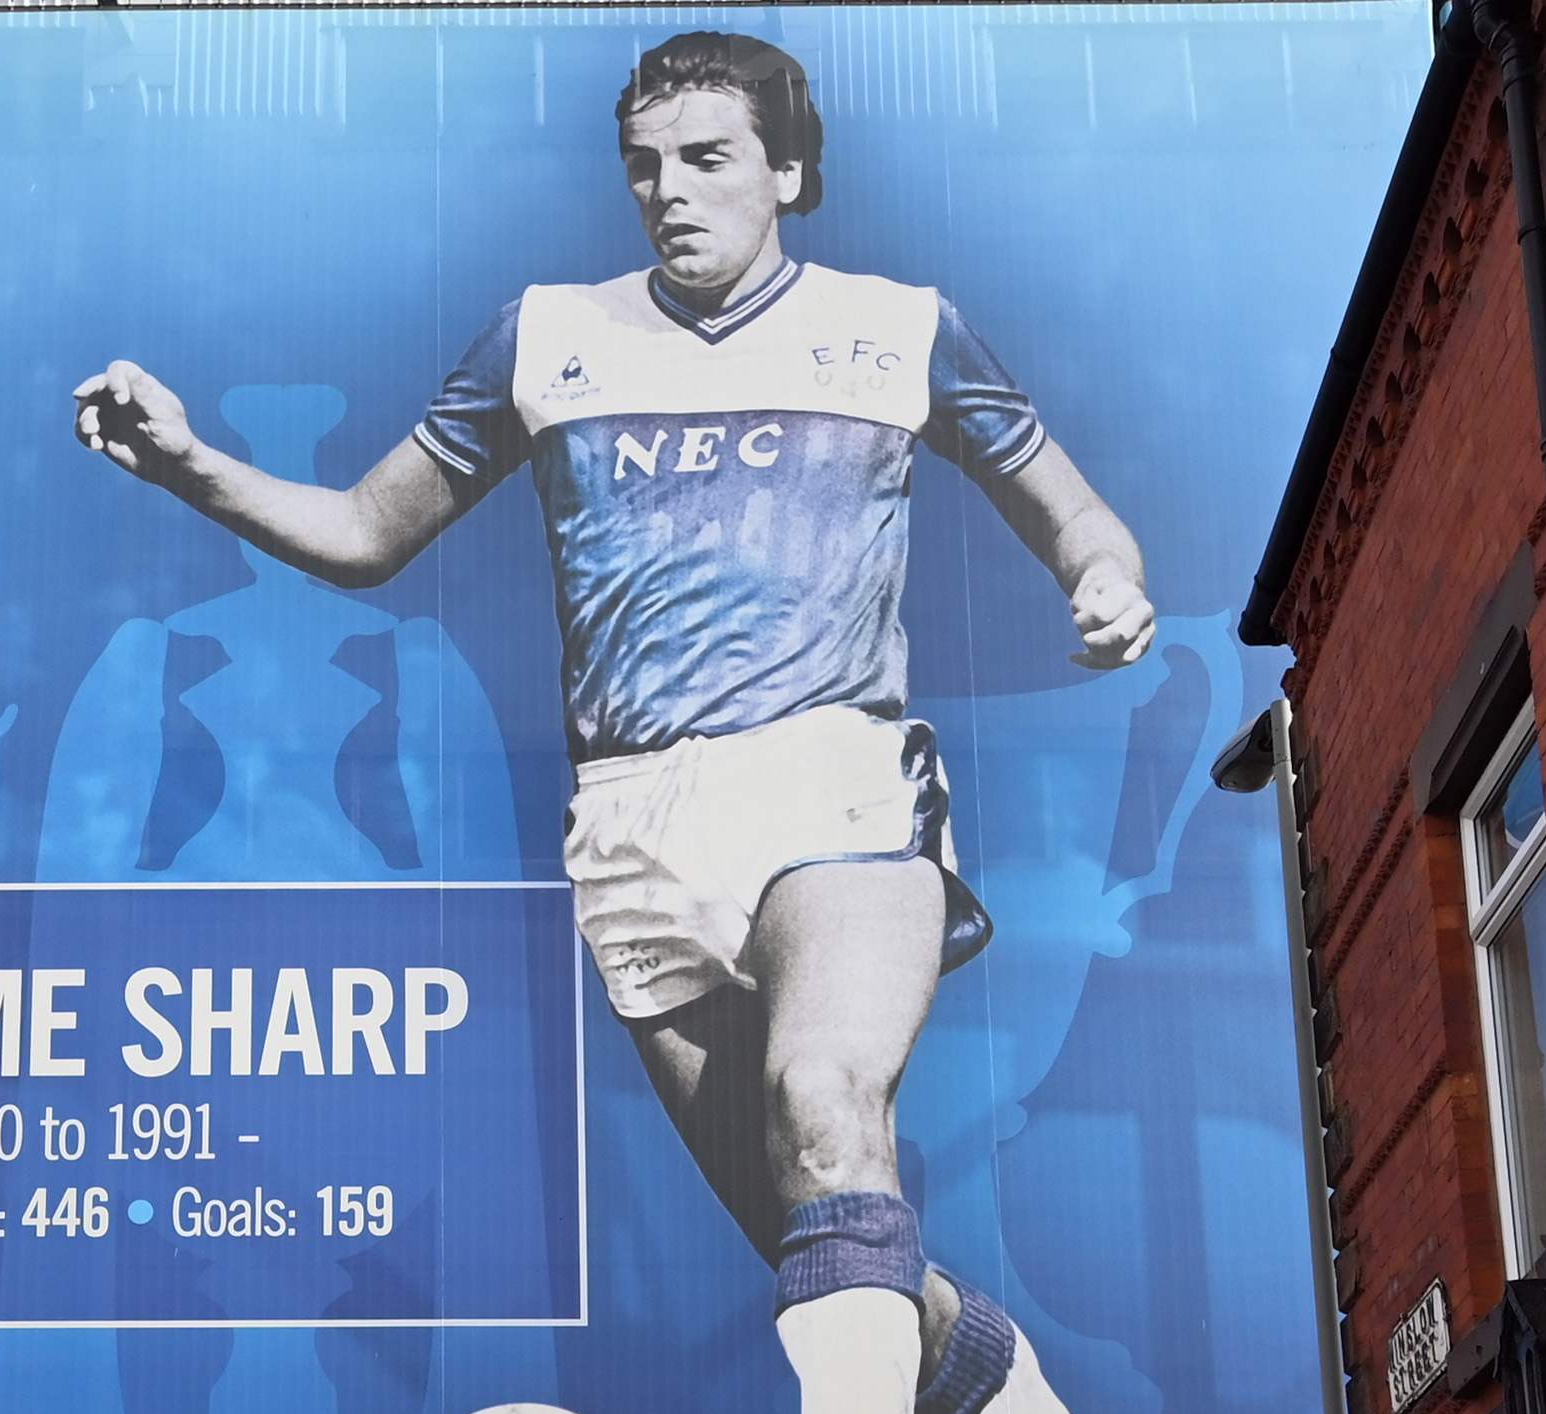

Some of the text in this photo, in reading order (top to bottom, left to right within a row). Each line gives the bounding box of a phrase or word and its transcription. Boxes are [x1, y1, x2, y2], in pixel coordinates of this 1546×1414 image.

[613, 423, 783, 481] NEC
[121, 967, 469, 1078] SHARP
[40, 1106, 86, 1162] to
[107, 1102, 215, 1161] 1991
[21, 1188, 109, 1238] 446
[172, 1187, 297, 1238] Goals:
[315, 1186, 394, 1236] 159
[1394, 1332, 1439, 1402] STREET
